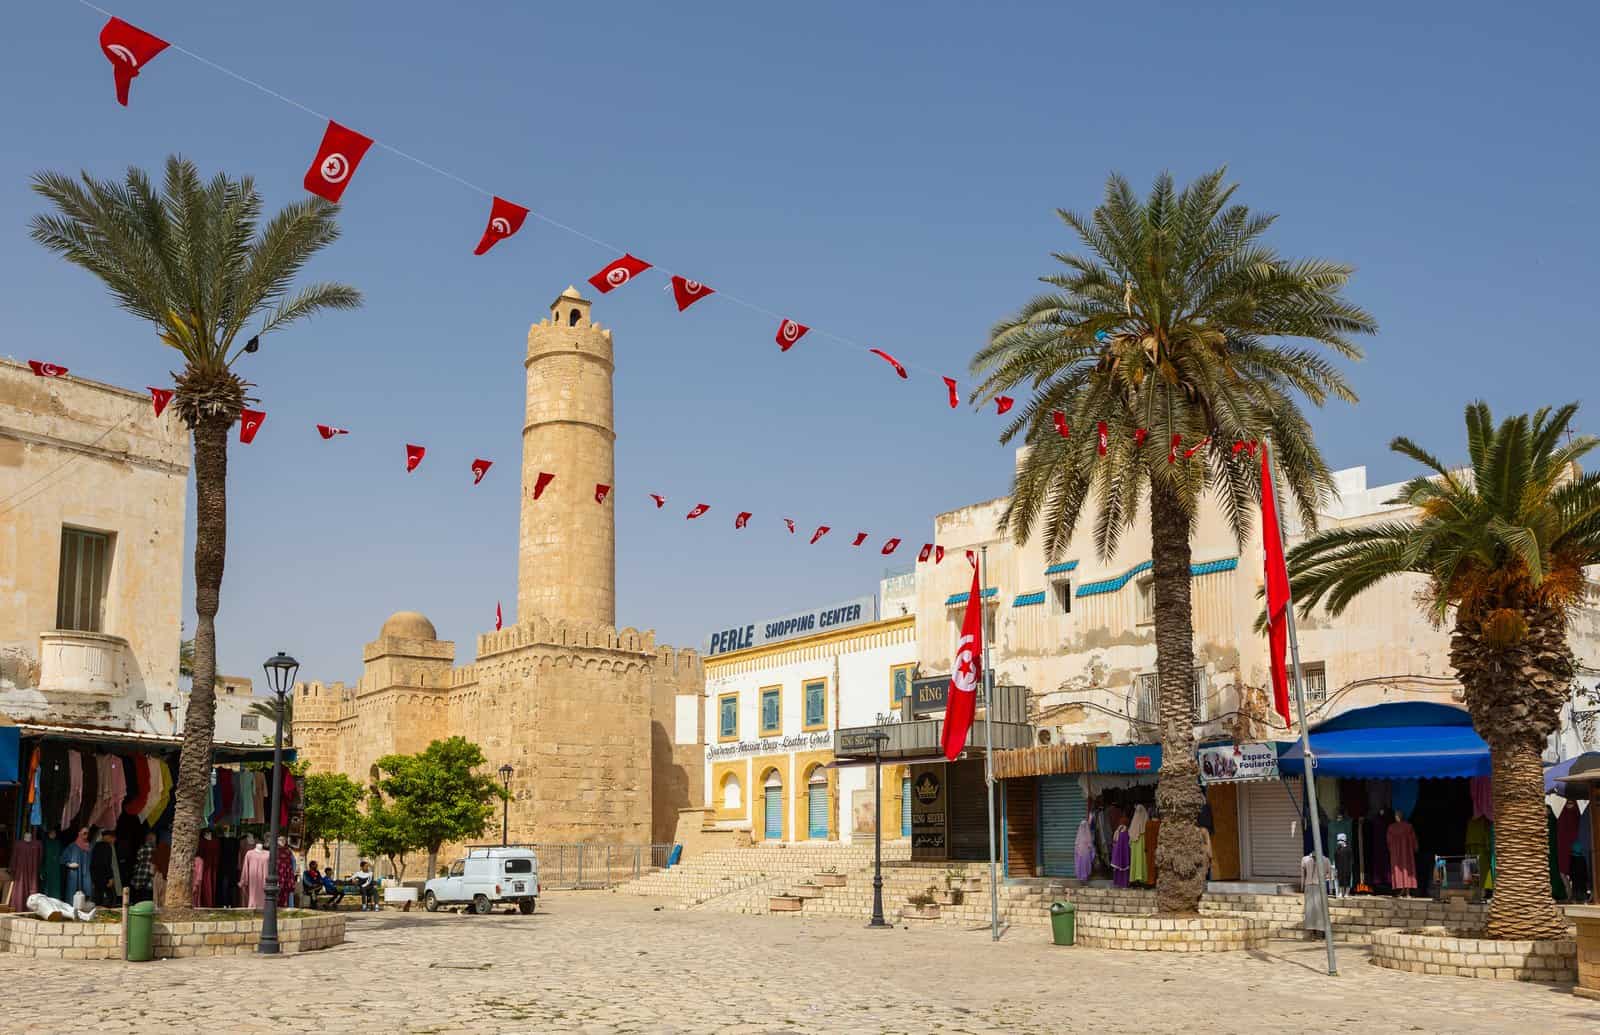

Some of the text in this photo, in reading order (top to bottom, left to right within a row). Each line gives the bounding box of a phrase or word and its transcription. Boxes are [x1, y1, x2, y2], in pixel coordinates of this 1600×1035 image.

[710, 604, 861, 655] PERLE SHOPPING CENTER
[1242, 753, 1272, 761] Espace
[1240, 760, 1275, 769] Foulards
